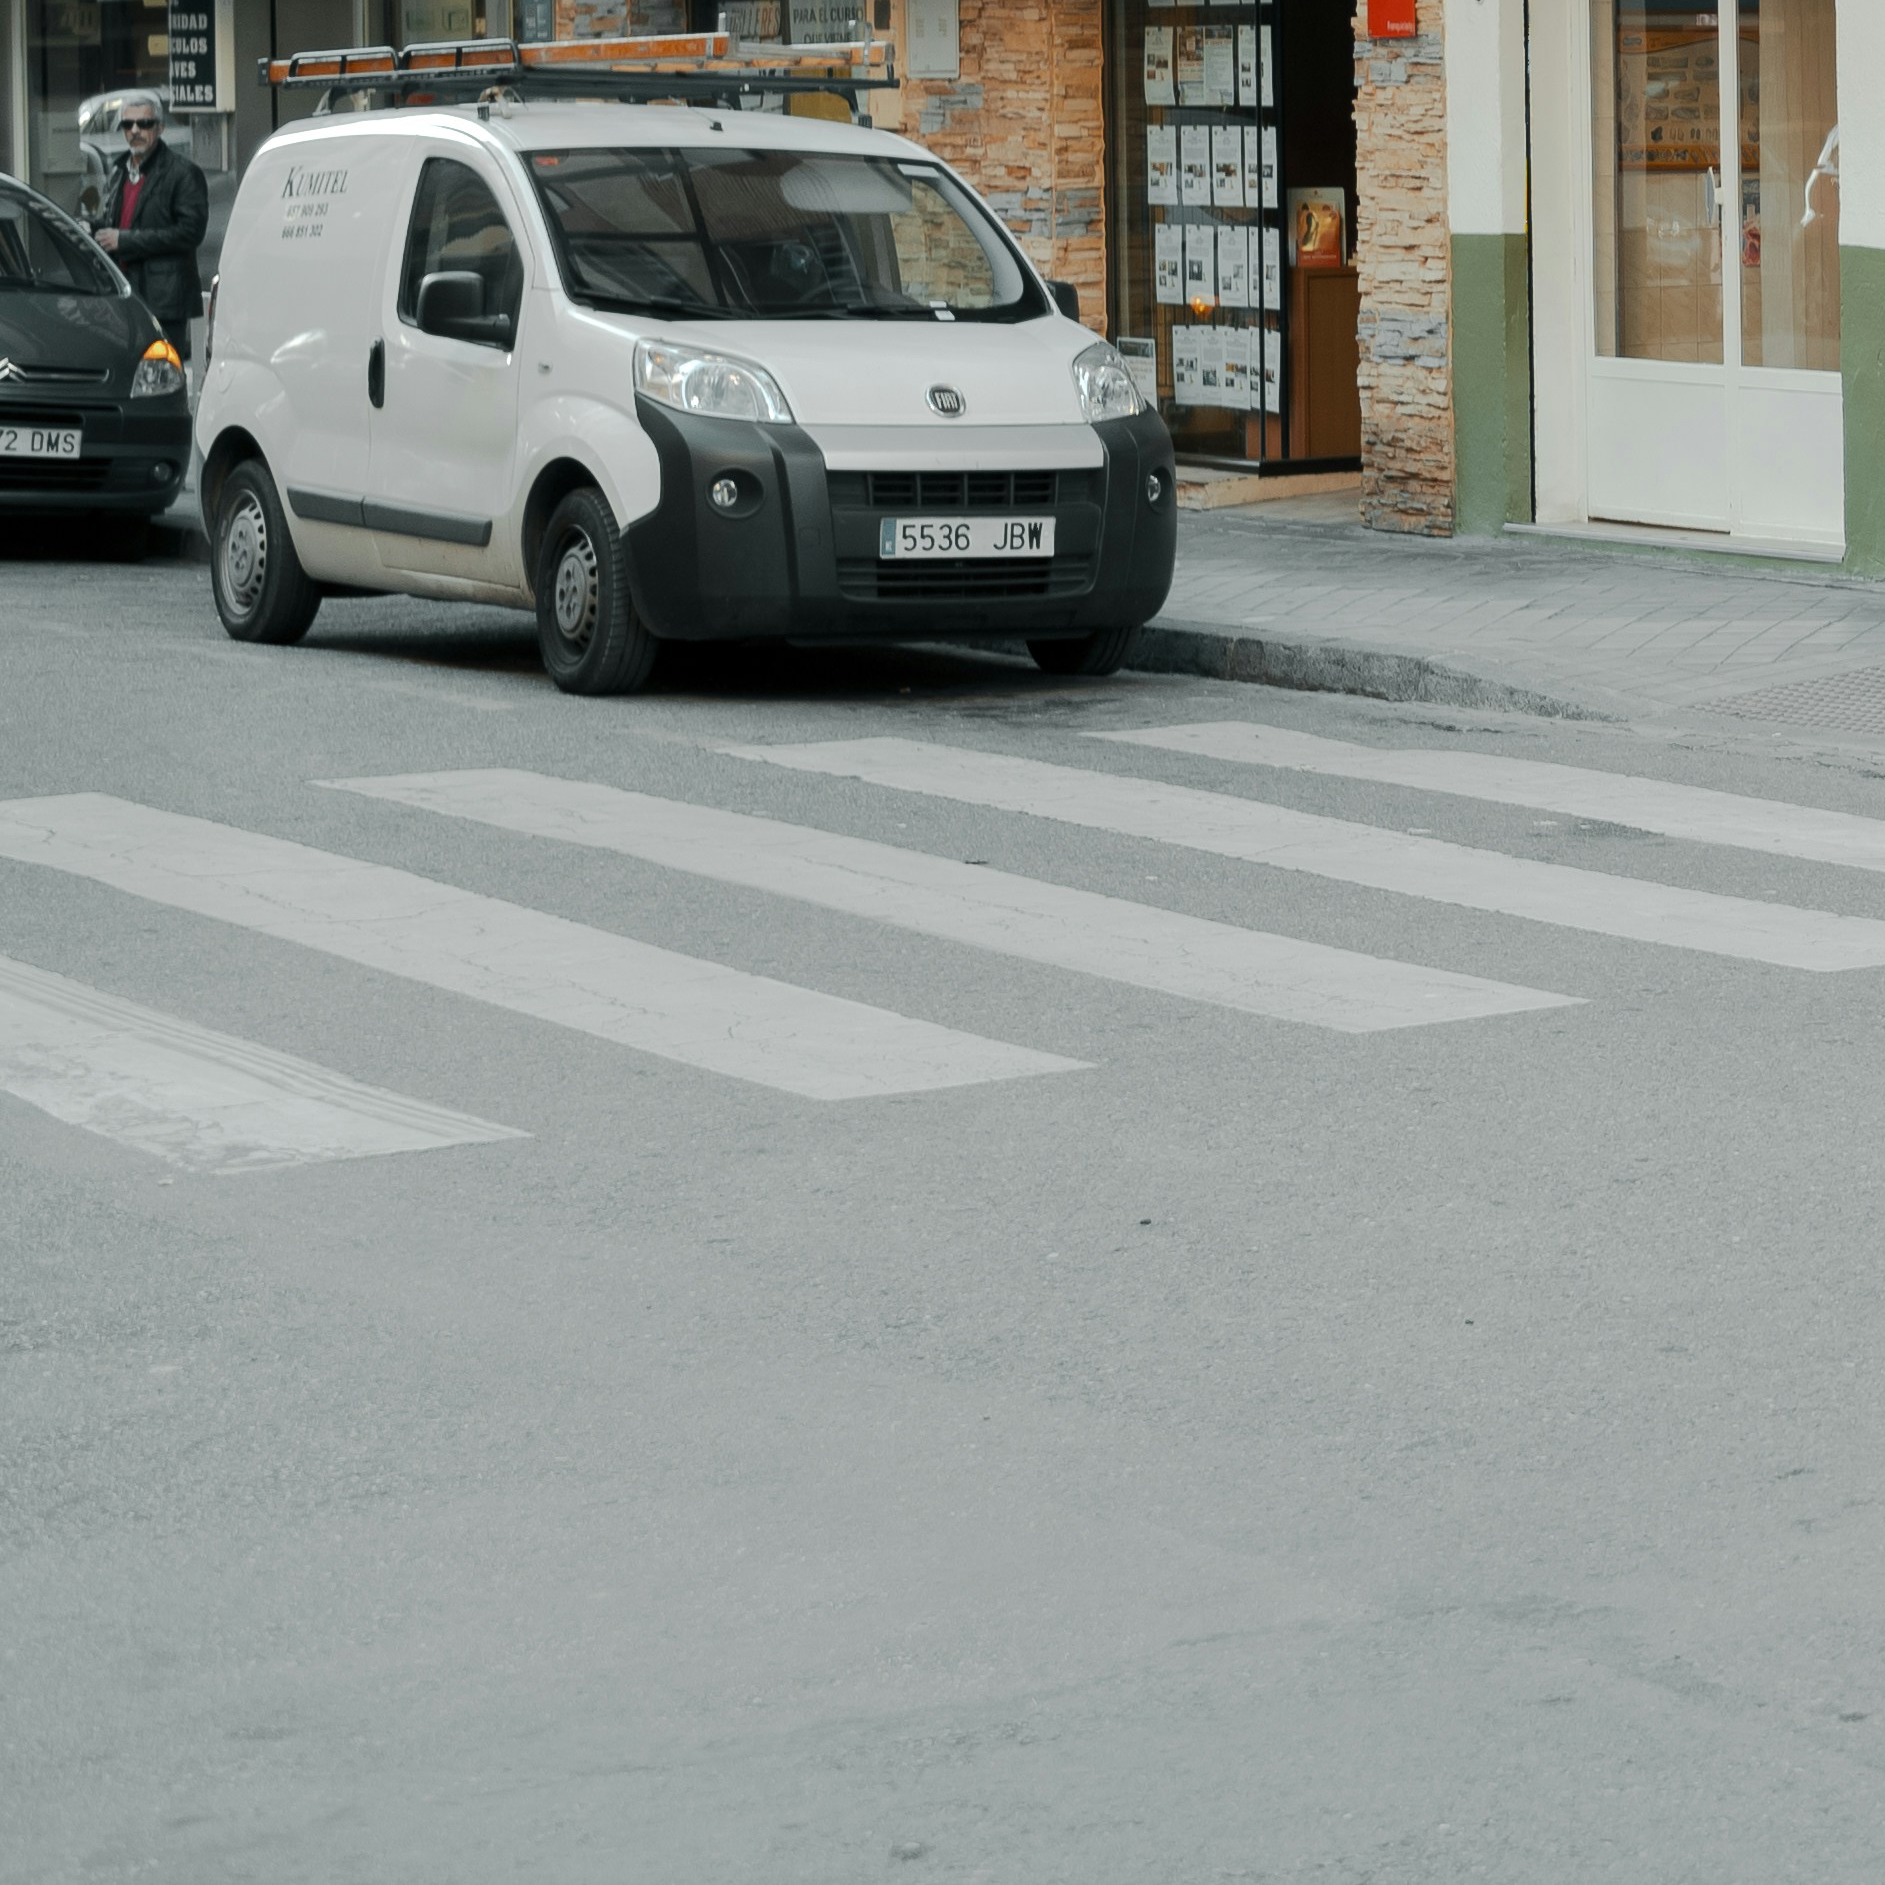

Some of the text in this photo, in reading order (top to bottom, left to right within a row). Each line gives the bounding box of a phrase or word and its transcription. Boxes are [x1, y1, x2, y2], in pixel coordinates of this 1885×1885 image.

[793, 7, 818, 24] PARA
[934, 391, 959, 410] FIAT
[30, 430, 76, 454] DMS
[901, 522, 1043, 551] 5536 JBW
